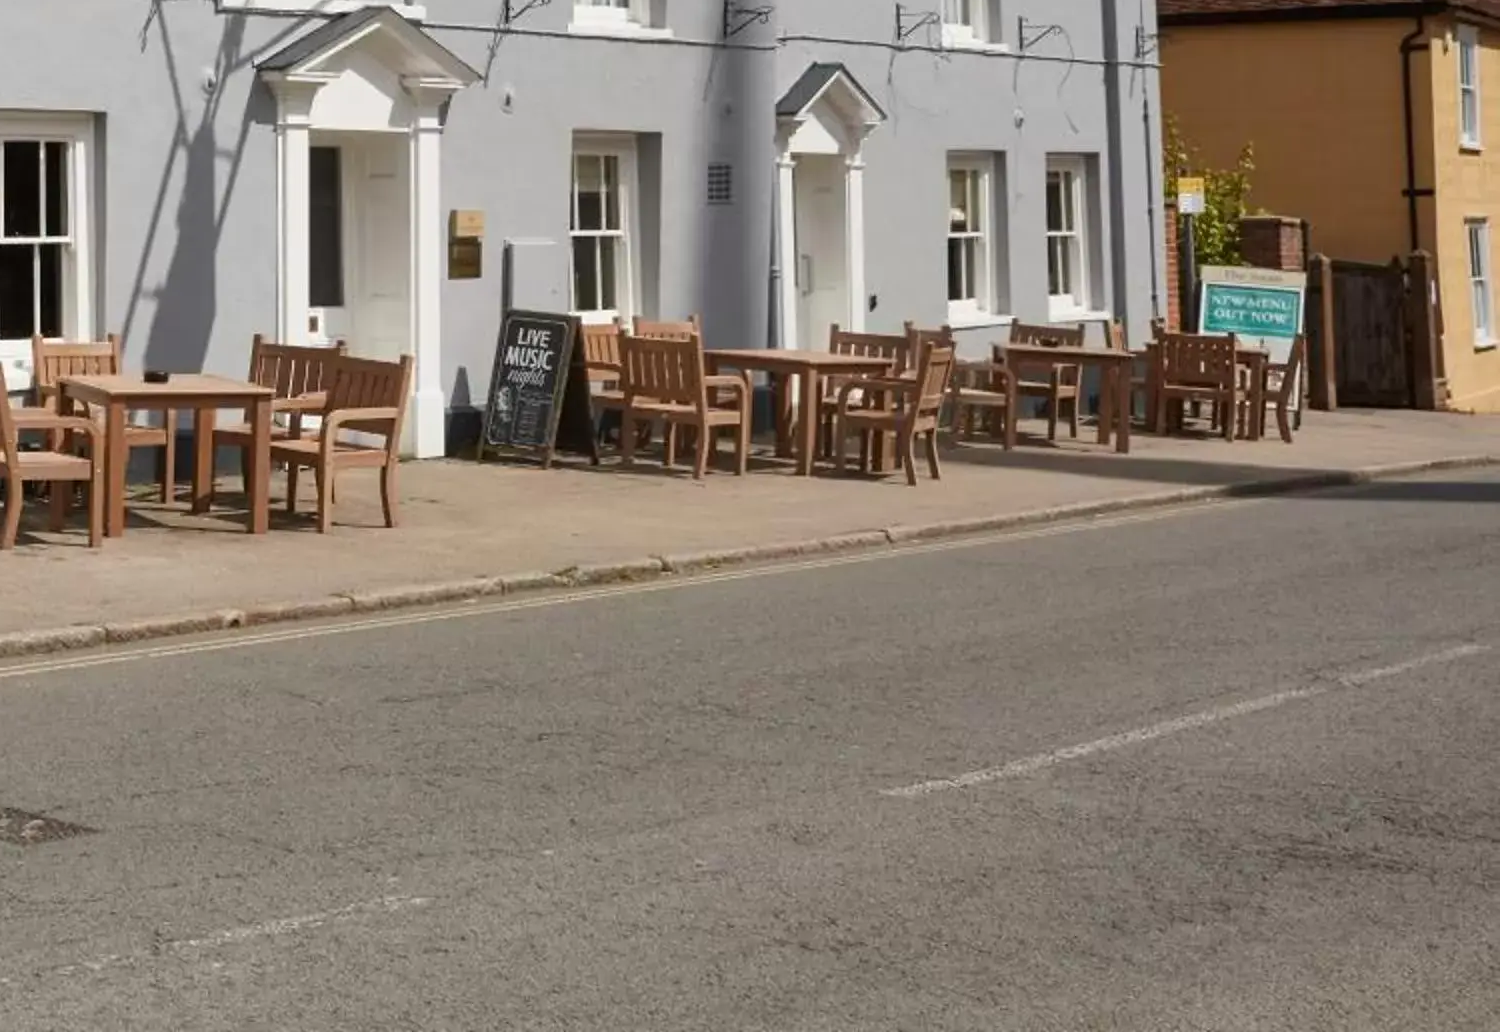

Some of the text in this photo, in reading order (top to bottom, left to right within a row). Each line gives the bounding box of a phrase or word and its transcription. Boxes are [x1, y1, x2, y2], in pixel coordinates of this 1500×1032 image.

[1211, 295, 1291, 311] NEW MENU
[1214, 307, 1288, 325] OUT NOW
[517, 327, 552, 348] LIVE
[504, 346, 555, 371] MUSIC
[507, 367, 546, 389] nights
